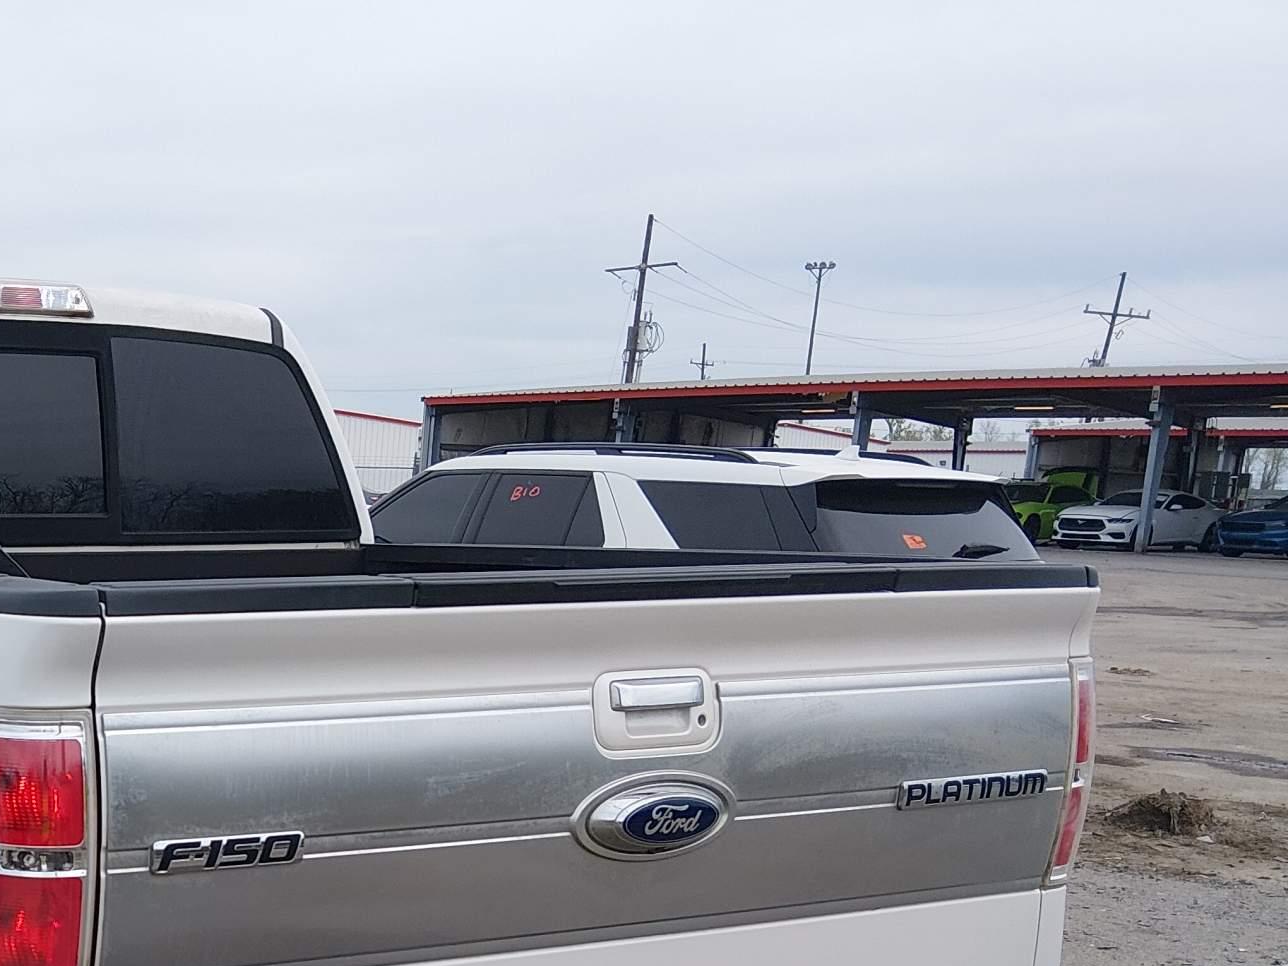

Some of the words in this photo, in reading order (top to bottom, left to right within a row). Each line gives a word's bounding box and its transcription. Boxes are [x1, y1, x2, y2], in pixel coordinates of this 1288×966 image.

[905, 772, 1047, 807] PLATINUM
[644, 804, 702, 836] Ford
[156, 833, 302, 872] F-150
